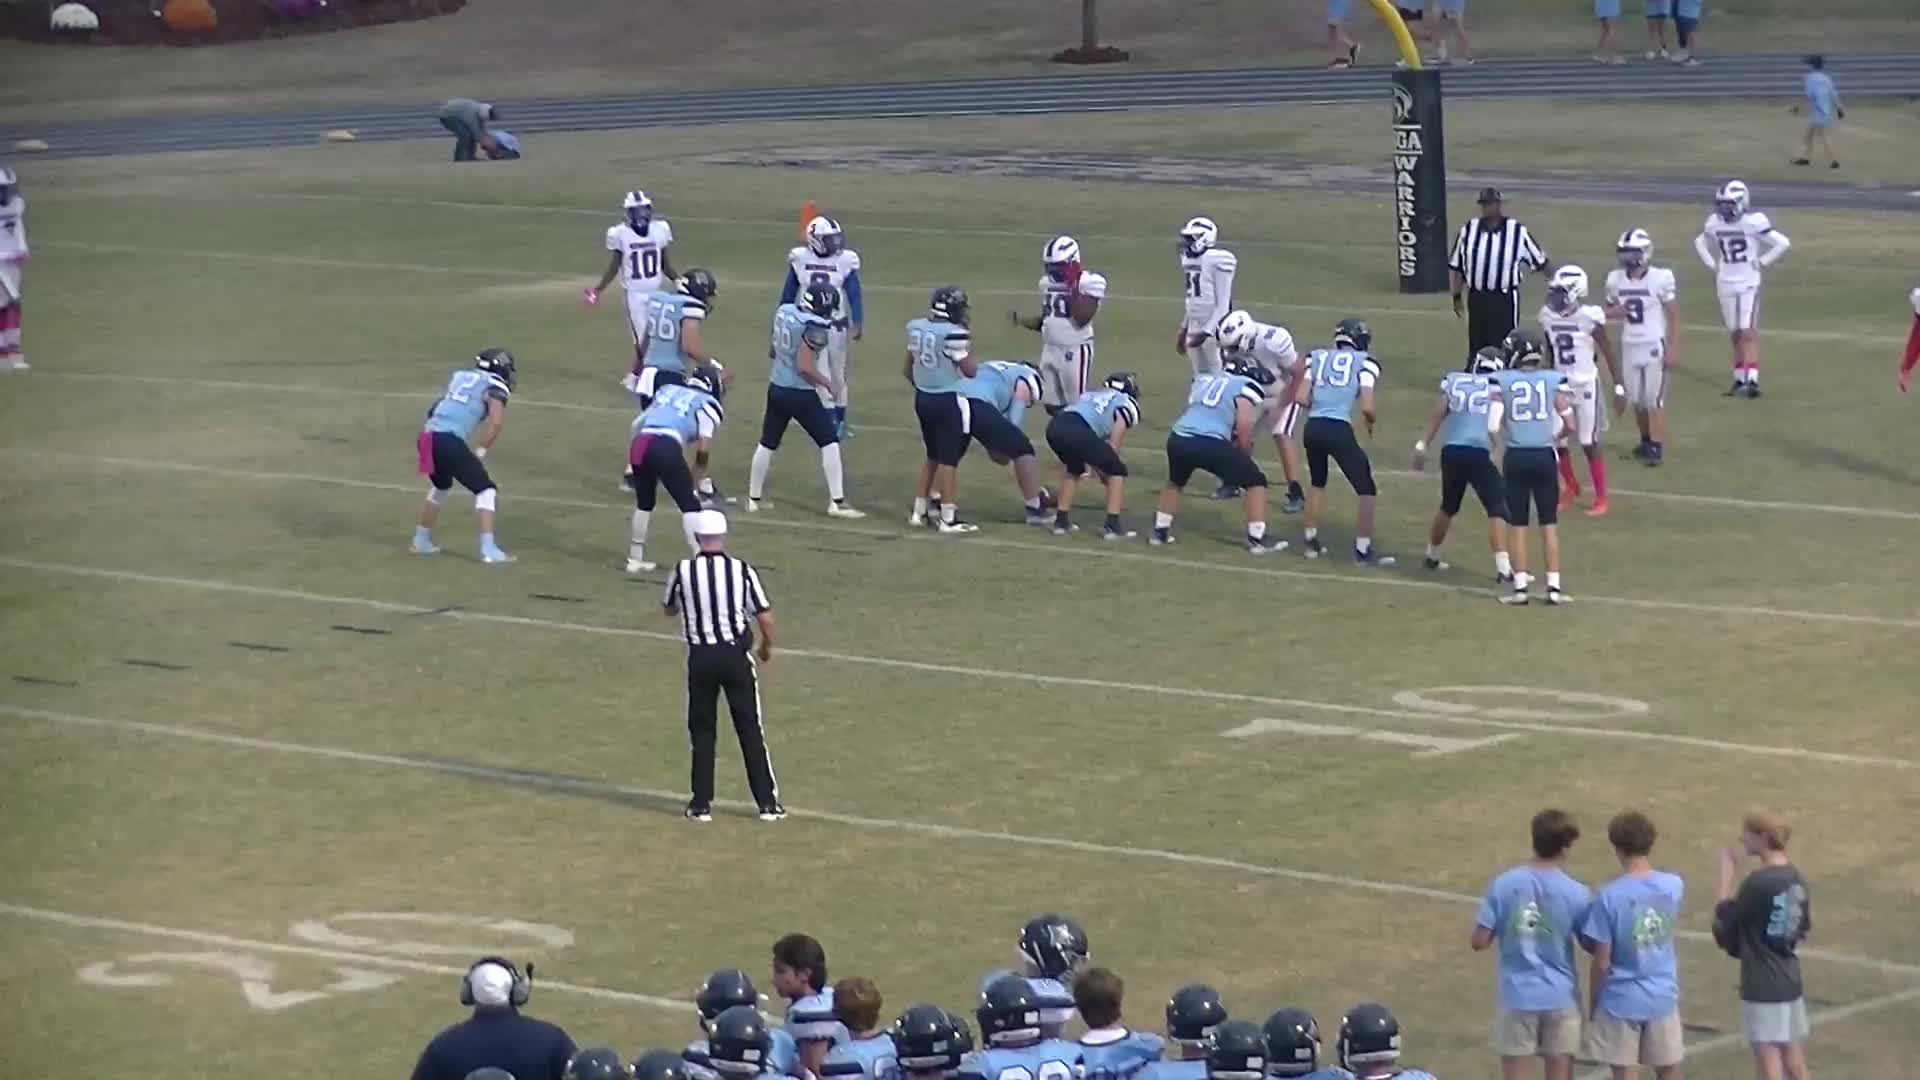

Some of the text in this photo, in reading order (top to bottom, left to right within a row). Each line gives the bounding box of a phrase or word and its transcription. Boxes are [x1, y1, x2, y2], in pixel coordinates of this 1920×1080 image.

[1395, 155, 1418, 276] WARRIORS
[630, 250, 658, 280] 10
[1556, 333, 1577, 366] 2
[1315, 351, 1354, 387] 19
[1449, 376, 1490, 416] 52
[1510, 379, 1549, 421] 21
